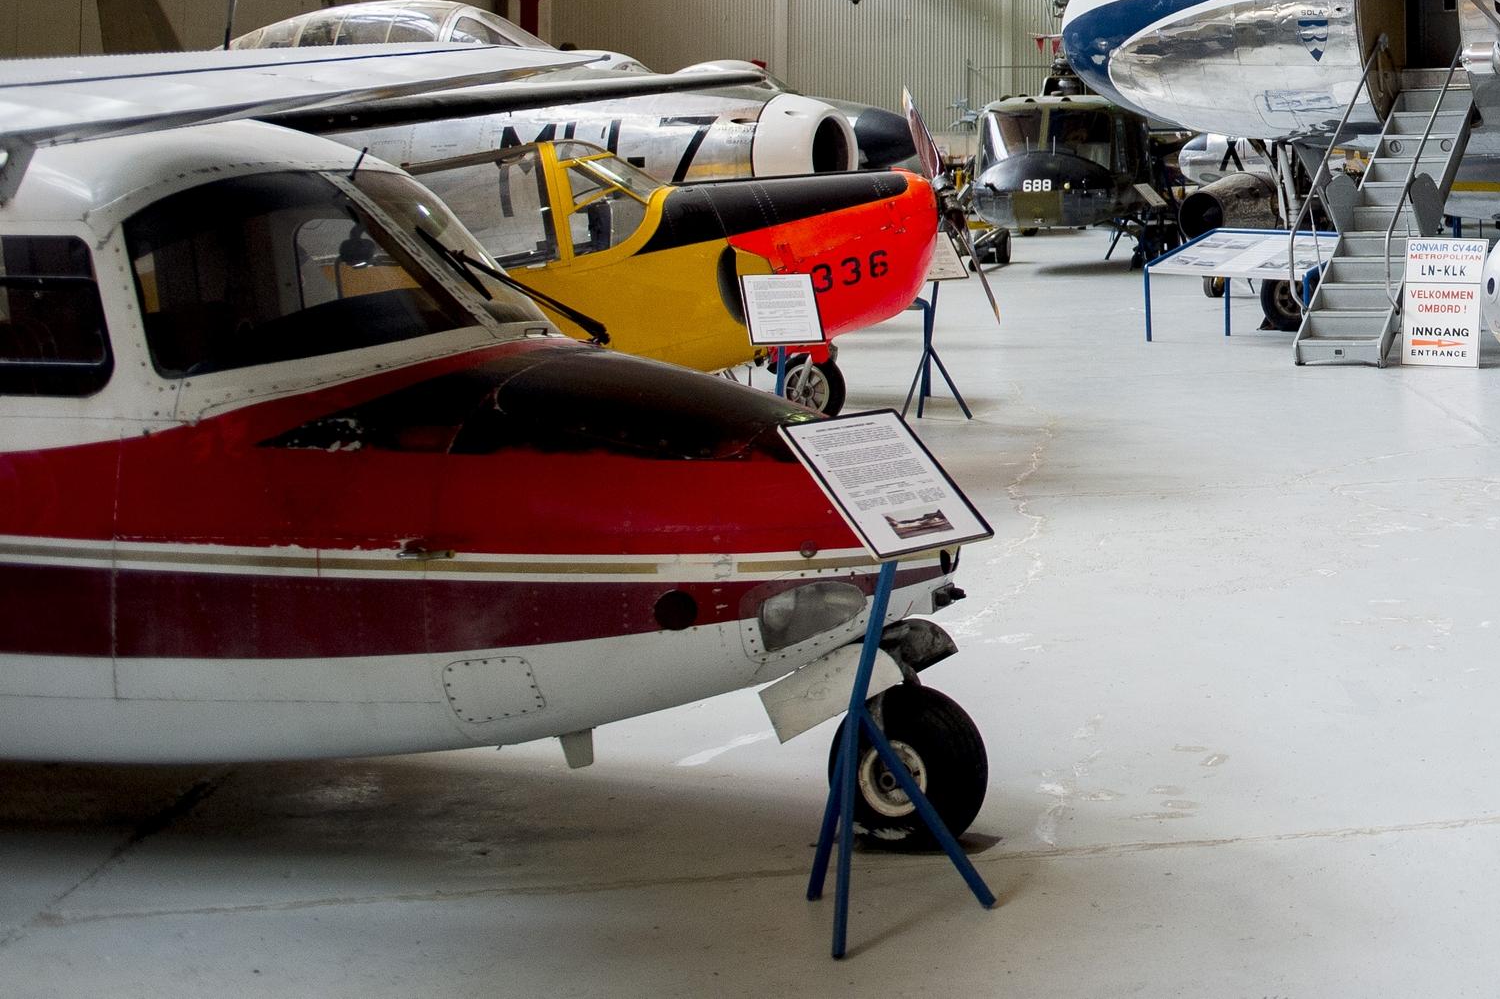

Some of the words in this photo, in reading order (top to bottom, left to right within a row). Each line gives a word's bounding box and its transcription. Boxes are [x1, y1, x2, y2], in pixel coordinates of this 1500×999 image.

[1023, 179, 1052, 192] 688
[1410, 243, 1449, 252] CONVAIR
[1452, 244, 1484, 253] CV440
[812, 249, 889, 294] 336
[1421, 265, 1467, 277] LN-KLK
[1410, 290, 1474, 300] VELKOMMEN
[1418, 304, 1461, 314] OMBORD
[1412, 327, 1470, 337] INNGANG
[1411, 349, 1468, 358] ENTRANCE
